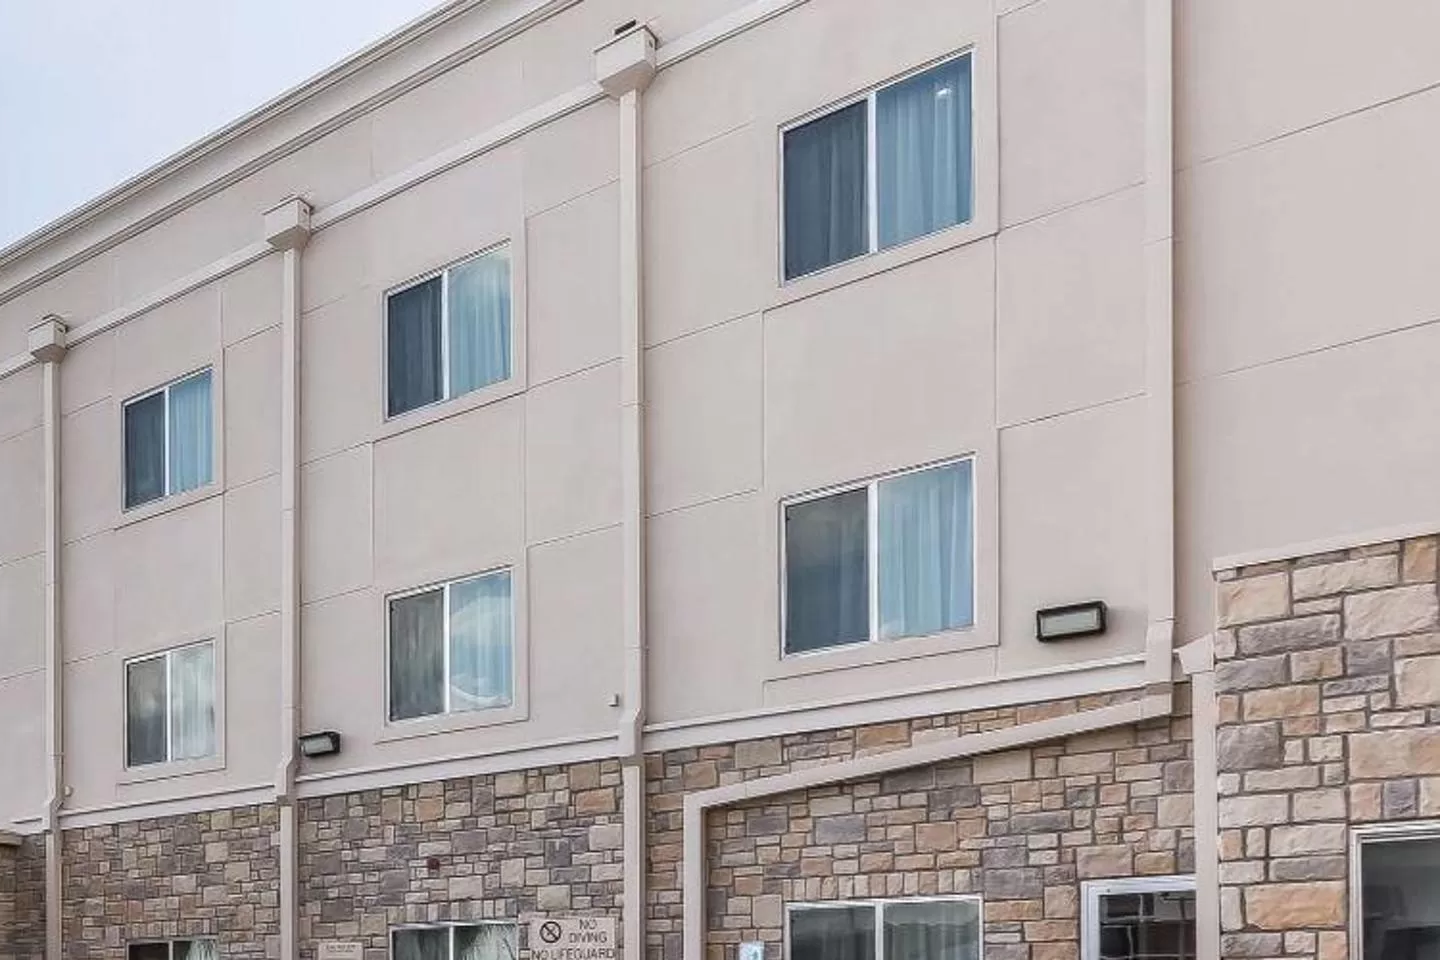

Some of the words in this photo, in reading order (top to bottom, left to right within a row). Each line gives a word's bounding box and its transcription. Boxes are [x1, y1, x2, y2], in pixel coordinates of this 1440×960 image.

[579, 918, 597, 930] NO
[568, 931, 608, 943] DIVING
[531, 949, 549, 960] NO
[551, 948, 615, 960] LIFEGUARD
